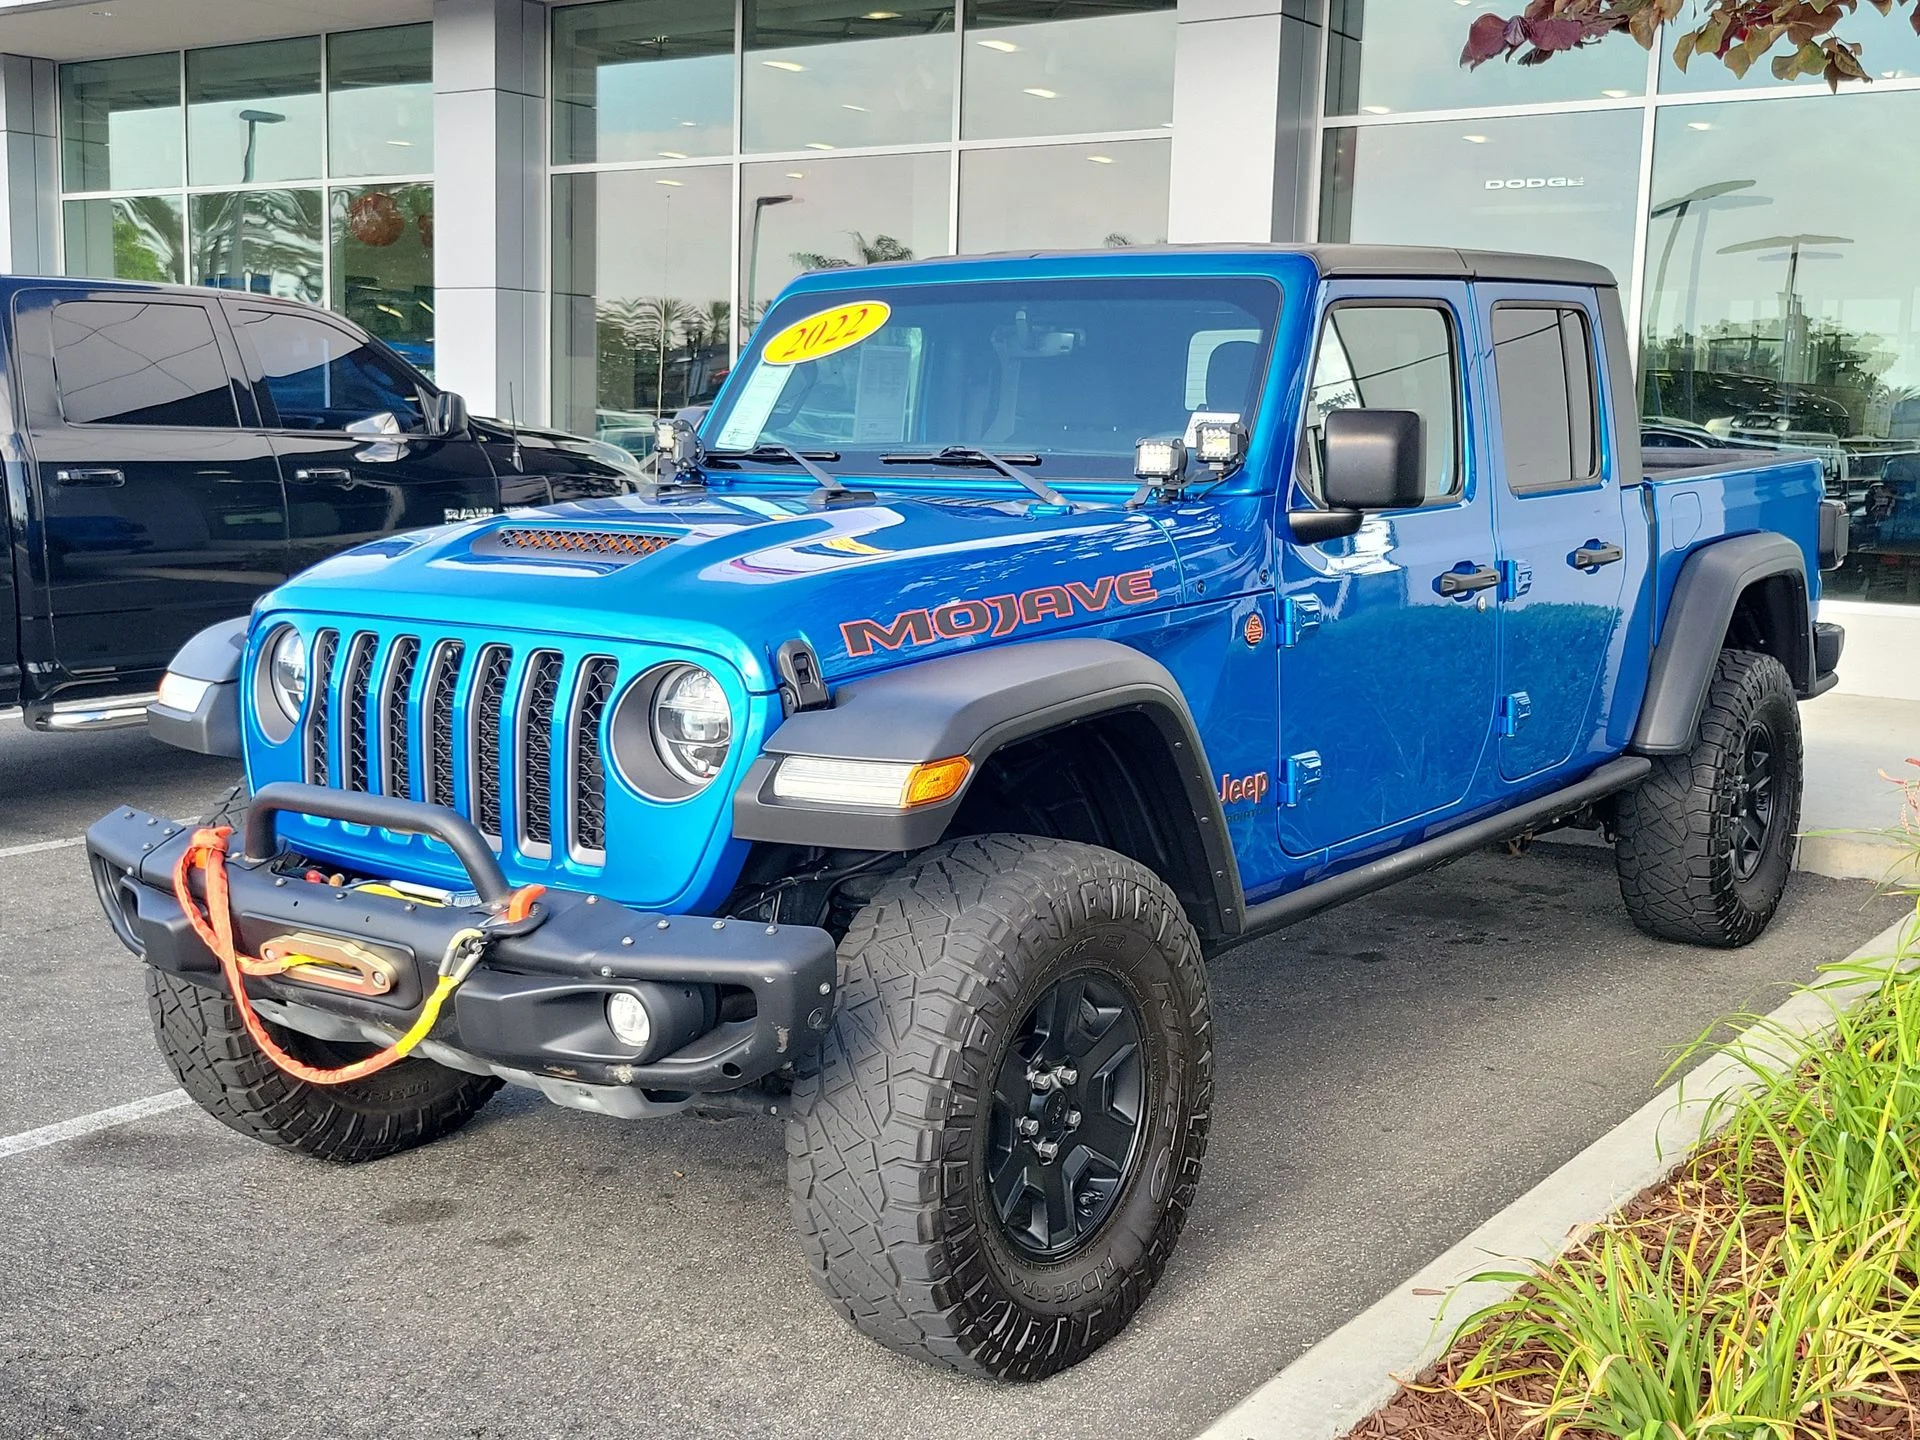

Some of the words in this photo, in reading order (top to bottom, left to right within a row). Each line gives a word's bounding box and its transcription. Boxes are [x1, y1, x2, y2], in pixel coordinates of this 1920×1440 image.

[1485, 176, 1584, 189] DODGE
[781, 308, 868, 358] 2022
[444, 507, 494, 521] RAM
[839, 568, 1158, 657] MOJAVE
[1220, 771, 1268, 805] Jeep
